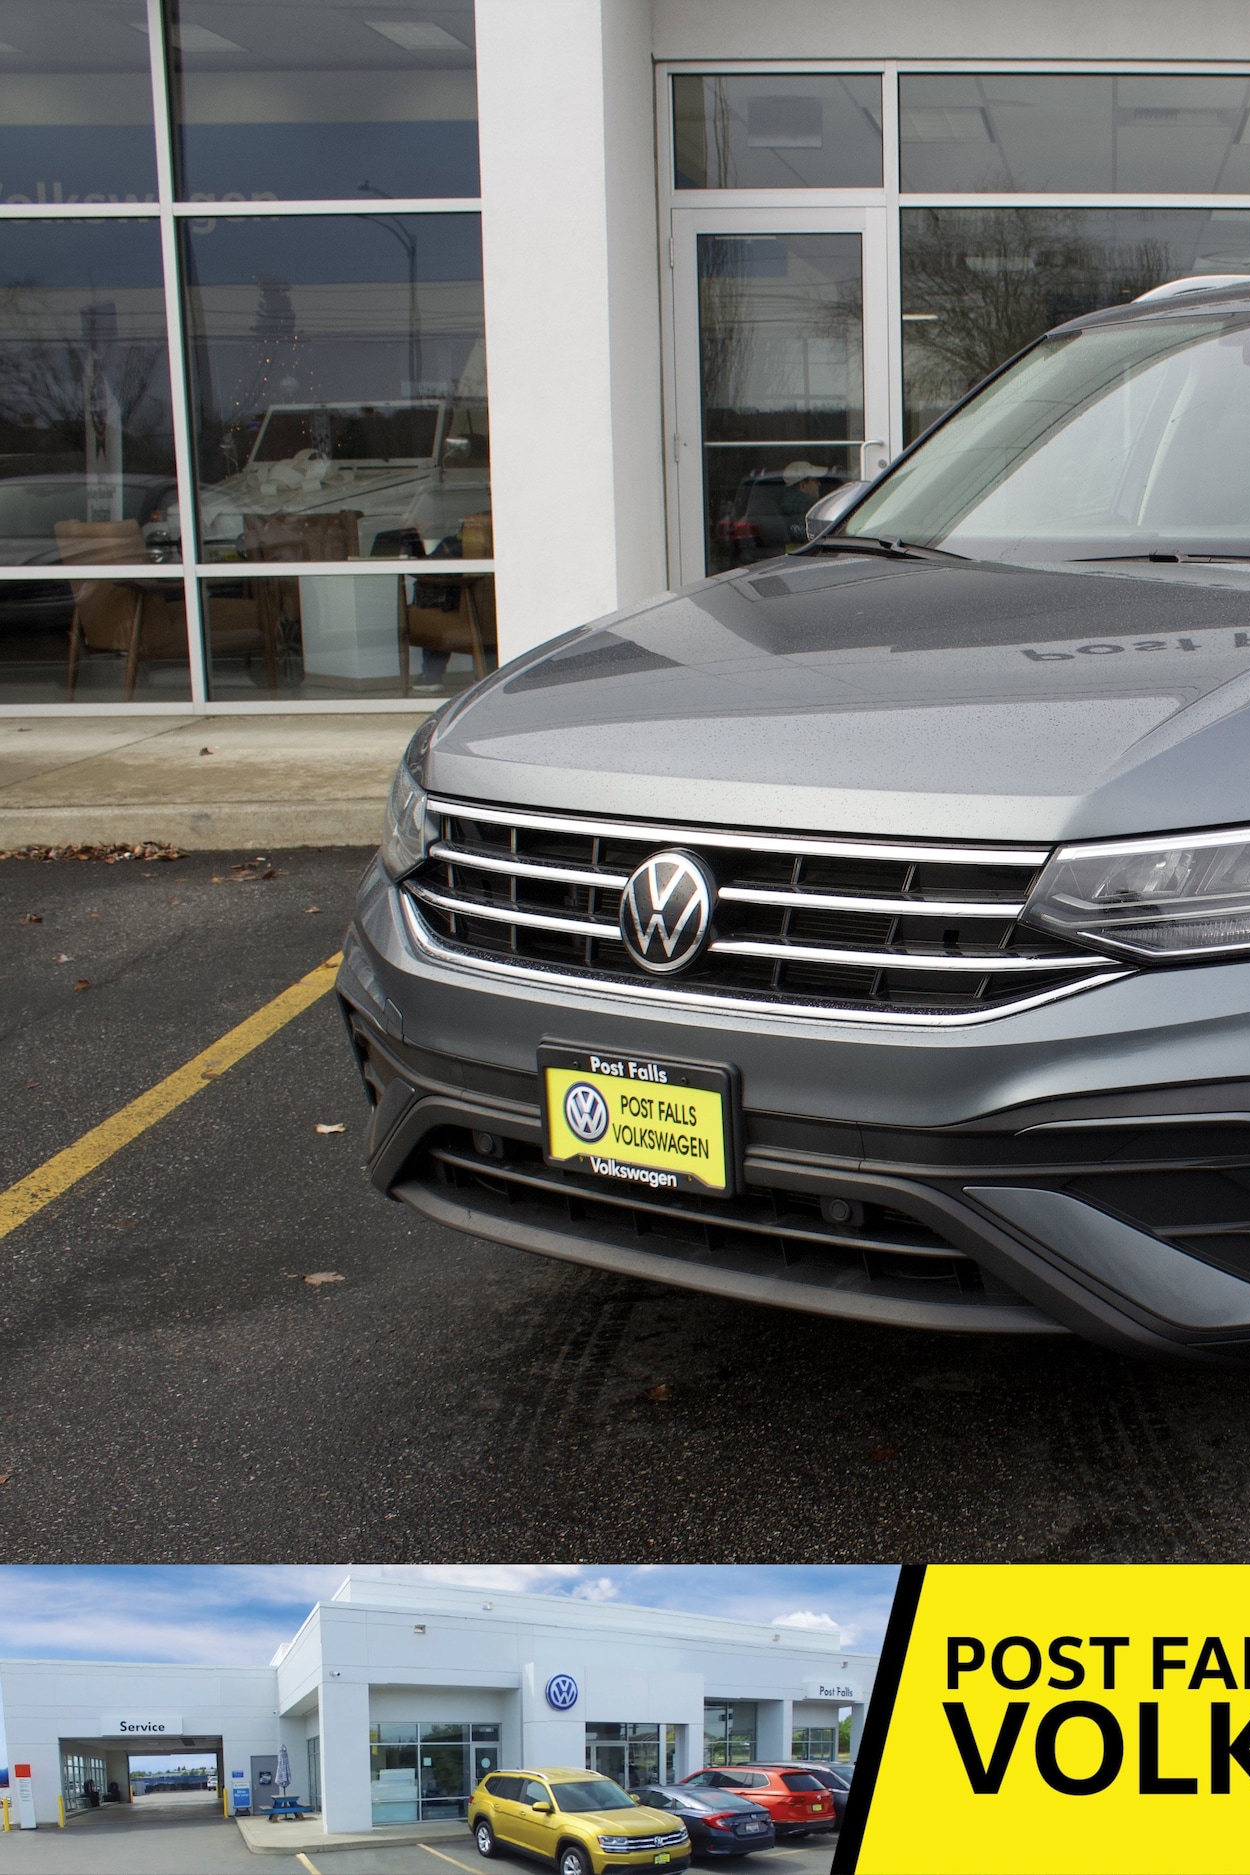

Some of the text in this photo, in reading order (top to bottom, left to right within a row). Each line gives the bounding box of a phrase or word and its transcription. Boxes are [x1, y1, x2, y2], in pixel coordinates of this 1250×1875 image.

[590, 1055, 668, 1084] Post Falls
[620, 1095, 697, 1126] POST FALLS
[612, 1122, 709, 1159] VOLKSWAGEN
[589, 1155, 677, 1187] Volkswagen
